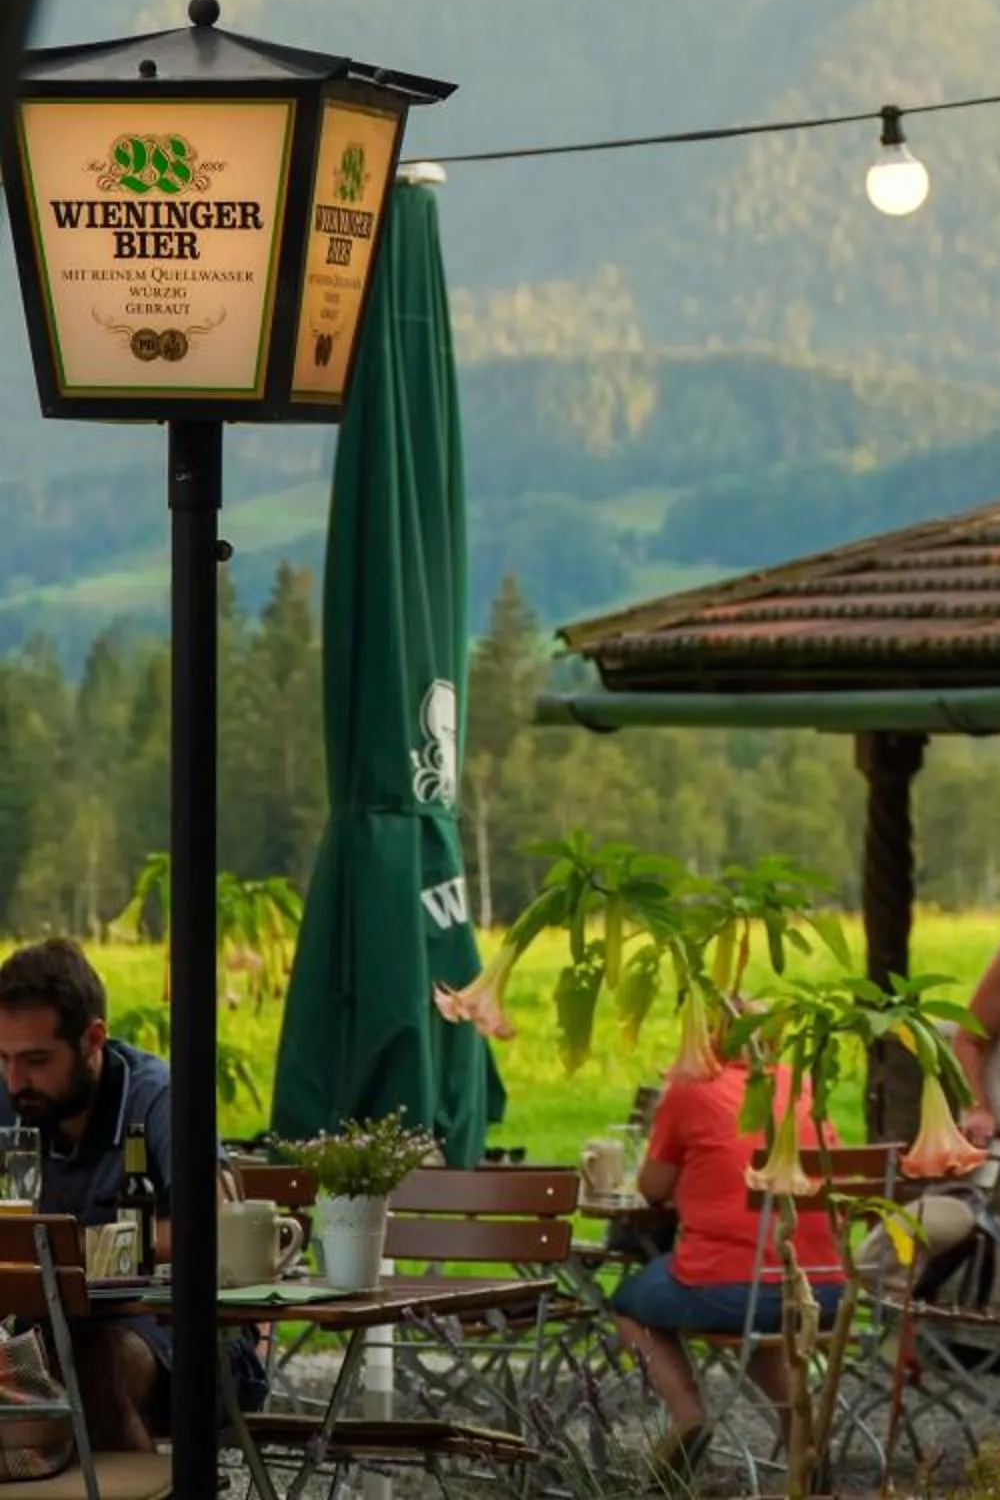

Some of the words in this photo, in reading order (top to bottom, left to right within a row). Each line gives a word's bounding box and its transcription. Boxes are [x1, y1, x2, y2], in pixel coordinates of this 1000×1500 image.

[50, 201, 264, 230] WIENINGER
[112, 231, 200, 260] BIER
[61, 268, 87, 282] MIT
[91, 268, 147, 282] REINEM
[125, 303, 191, 316] GEBRAUT
